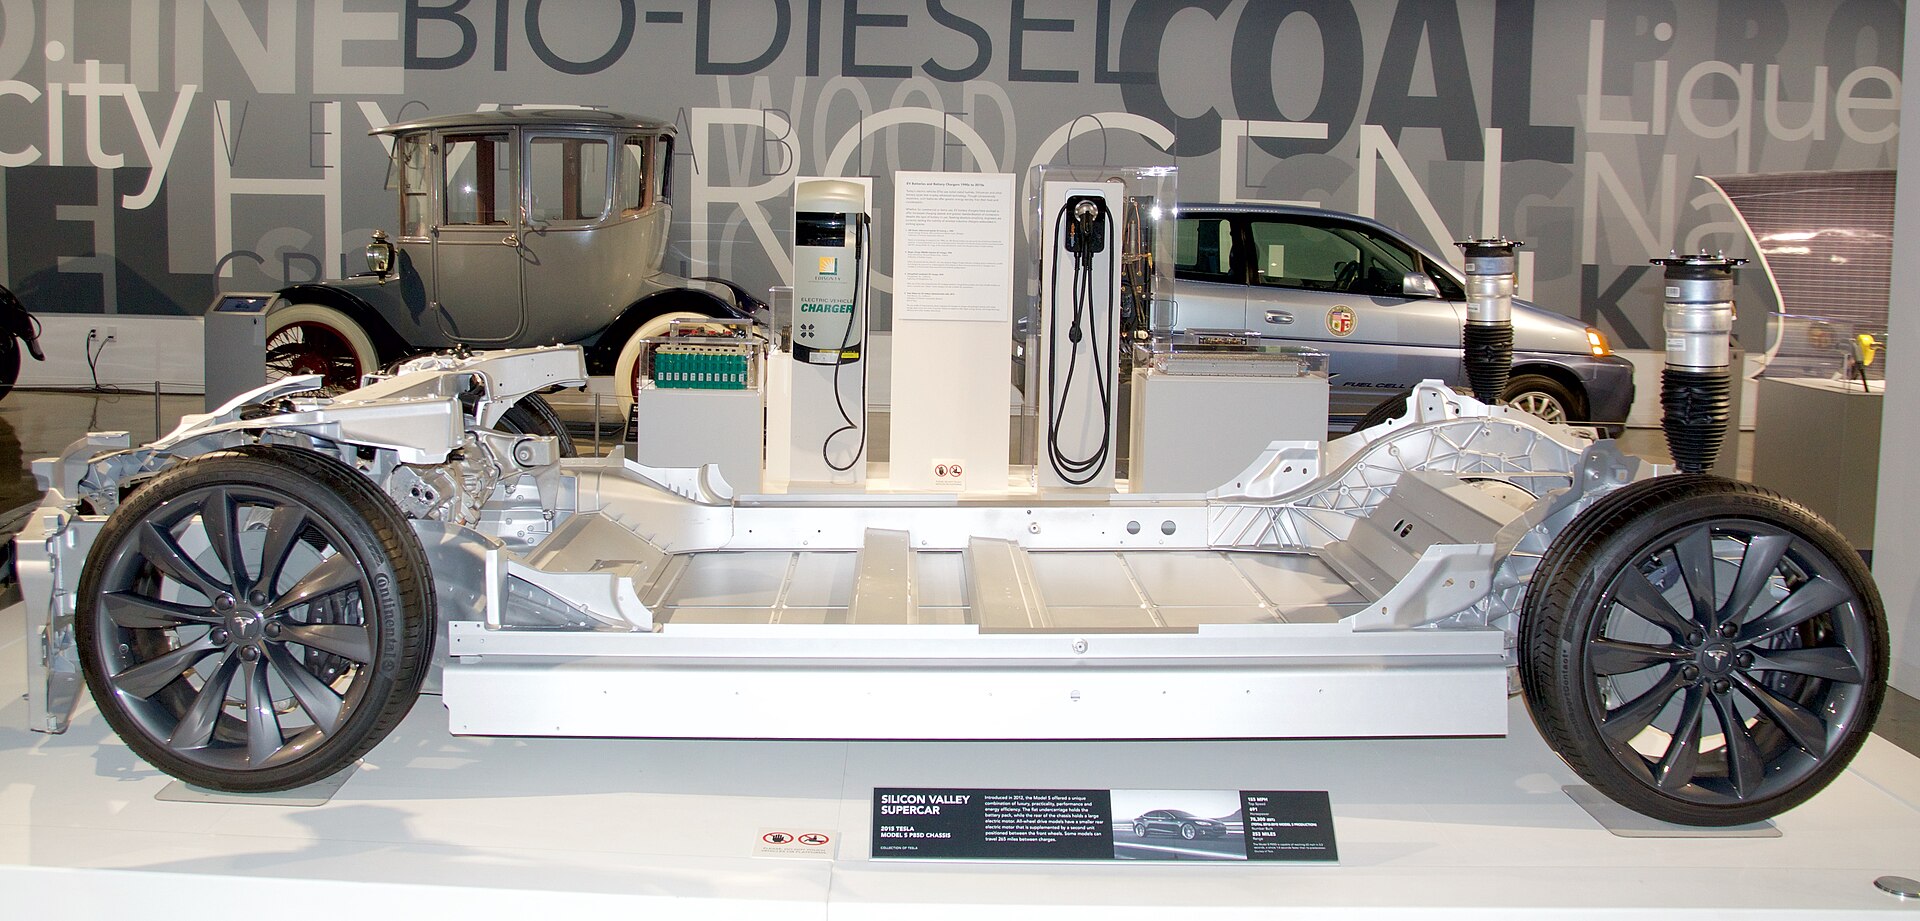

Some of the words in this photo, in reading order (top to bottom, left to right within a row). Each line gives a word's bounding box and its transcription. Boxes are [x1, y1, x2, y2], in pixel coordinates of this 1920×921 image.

[1119, 0, 1574, 164] COAL
[801, 303, 853, 313] CHARGER
[374, 572, 397, 658] Continental
[881, 794, 926, 805] SILICON
[928, 795, 970, 805] VALLEY
[881, 805, 941, 815] SUPERCAR
